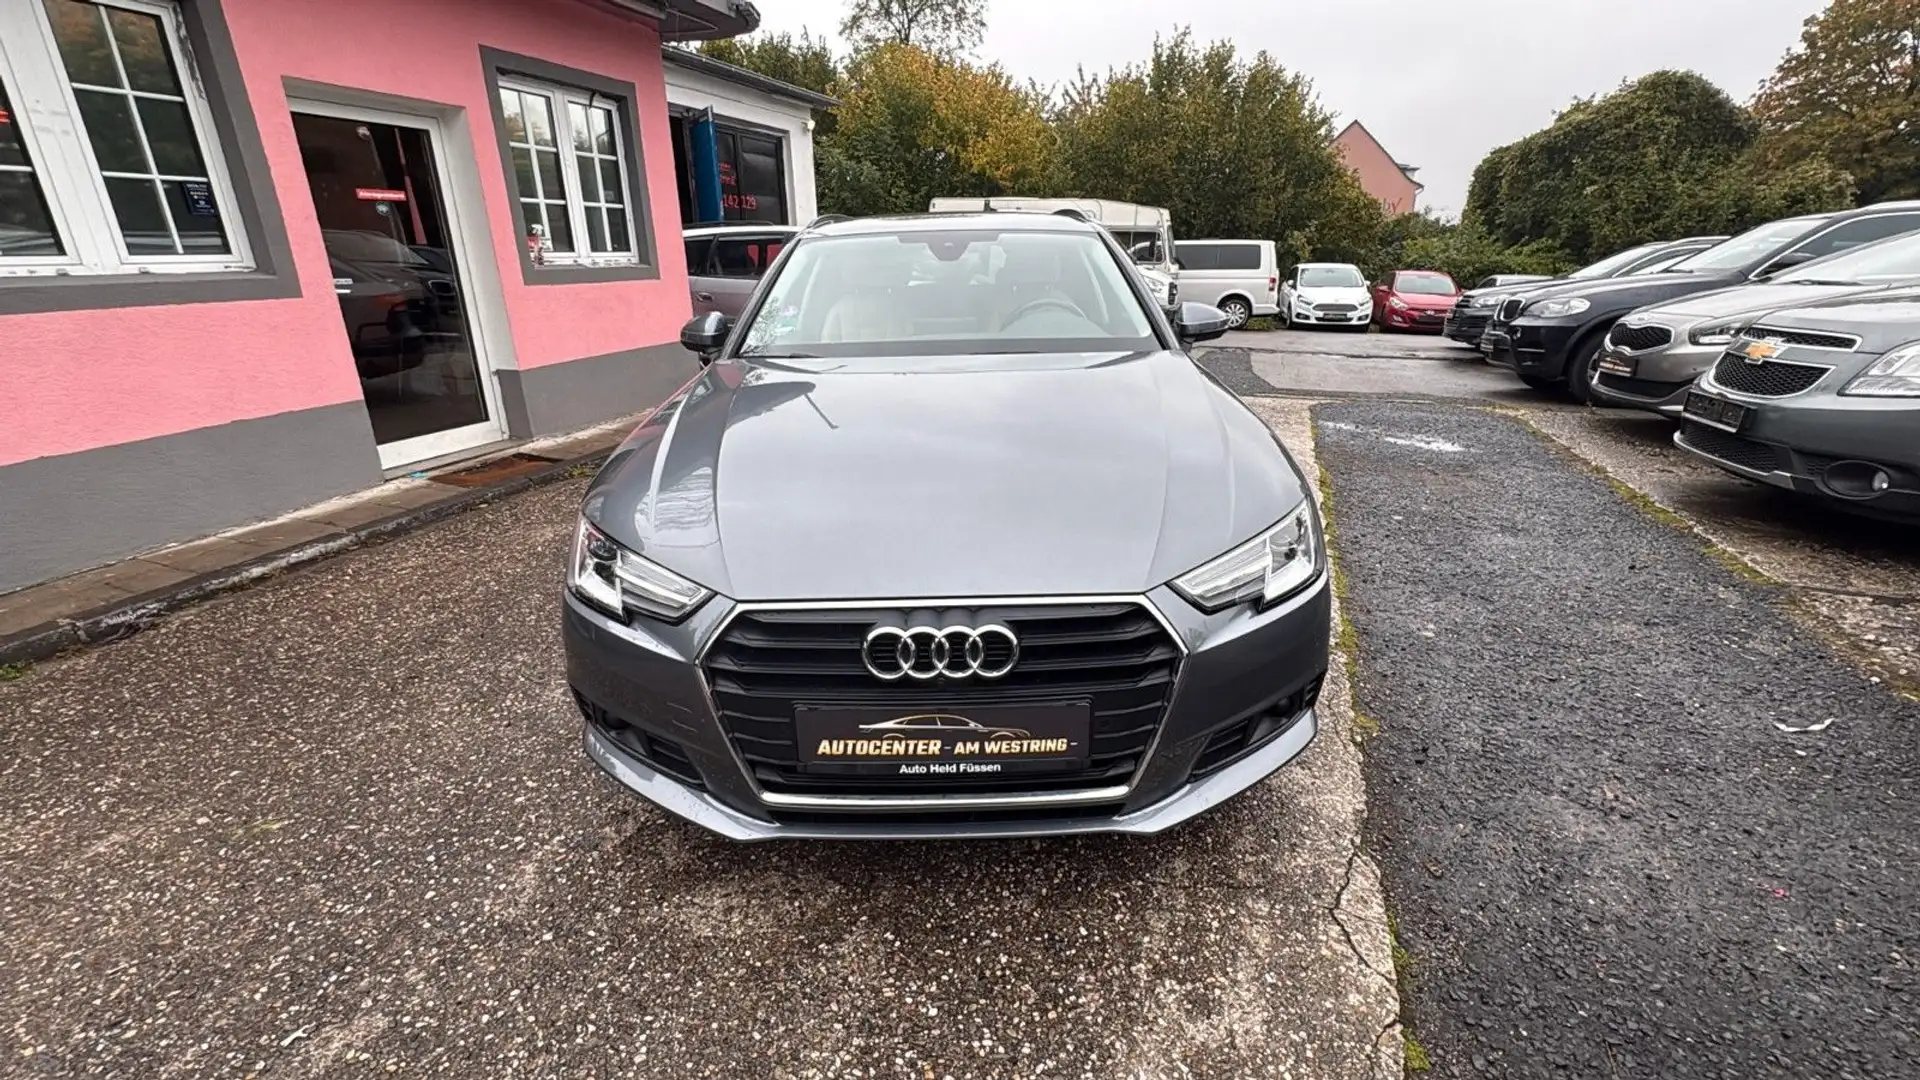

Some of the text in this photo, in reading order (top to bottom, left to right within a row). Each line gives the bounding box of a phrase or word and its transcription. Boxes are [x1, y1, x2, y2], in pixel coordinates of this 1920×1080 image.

[817, 739, 942, 755] AUTOCENTER
[953, 741, 980, 755] AM
[983, 738, 1068, 754] WESTRING
[899, 763, 1001, 774] Auto Held Füssen
